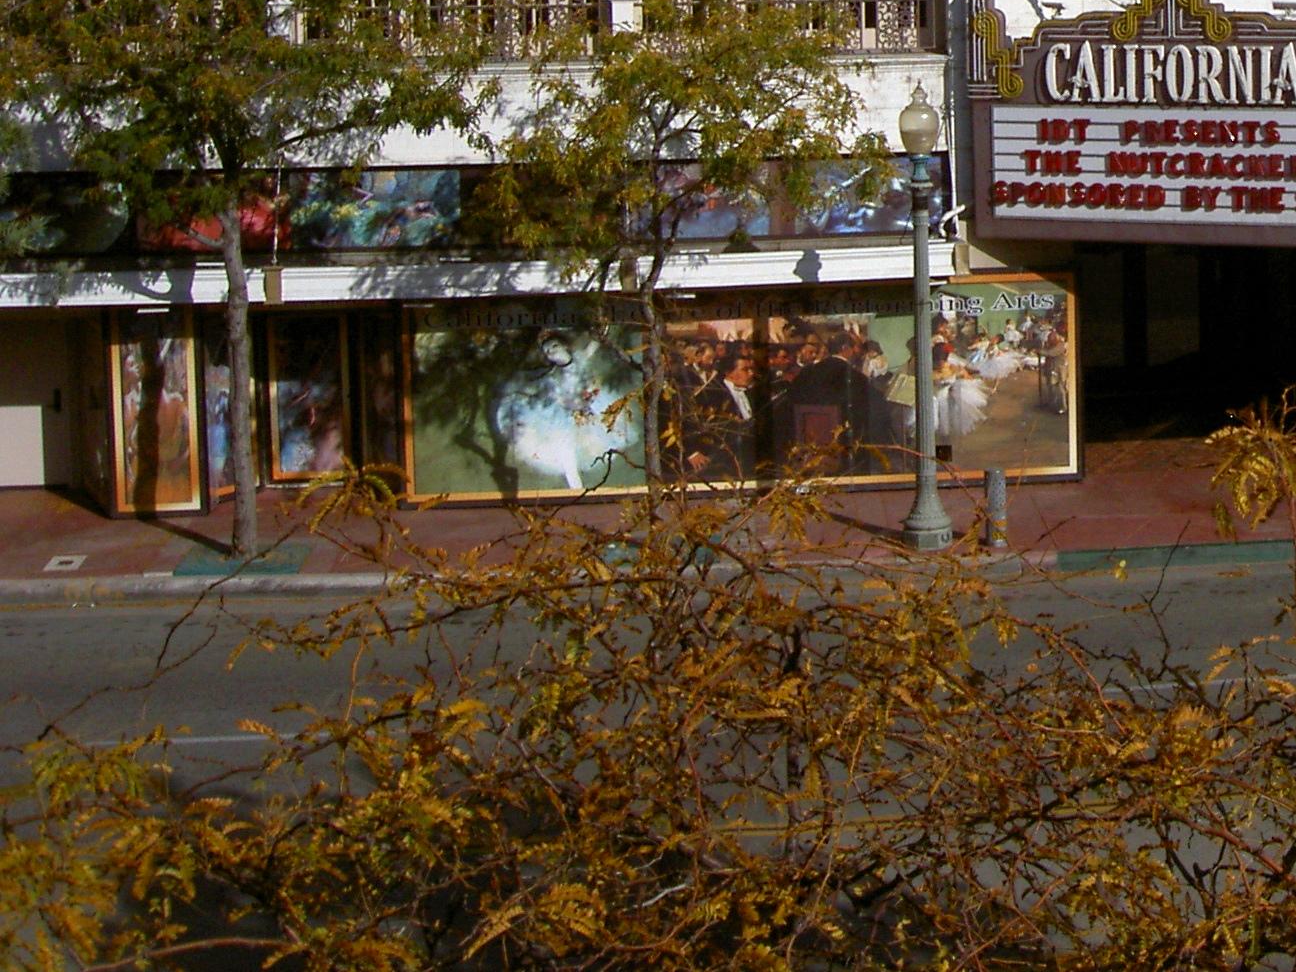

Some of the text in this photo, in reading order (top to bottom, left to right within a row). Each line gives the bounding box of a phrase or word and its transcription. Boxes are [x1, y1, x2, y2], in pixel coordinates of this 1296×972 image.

[1118, 119, 1281, 147] PRESENTS
[1022, 149, 1082, 177] THE
[990, 180, 1165, 210] SPONSORED
[1180, 186, 1222, 212] BY
[1226, 186, 1286, 213] THE
[992, 290, 1055, 311] Arts
